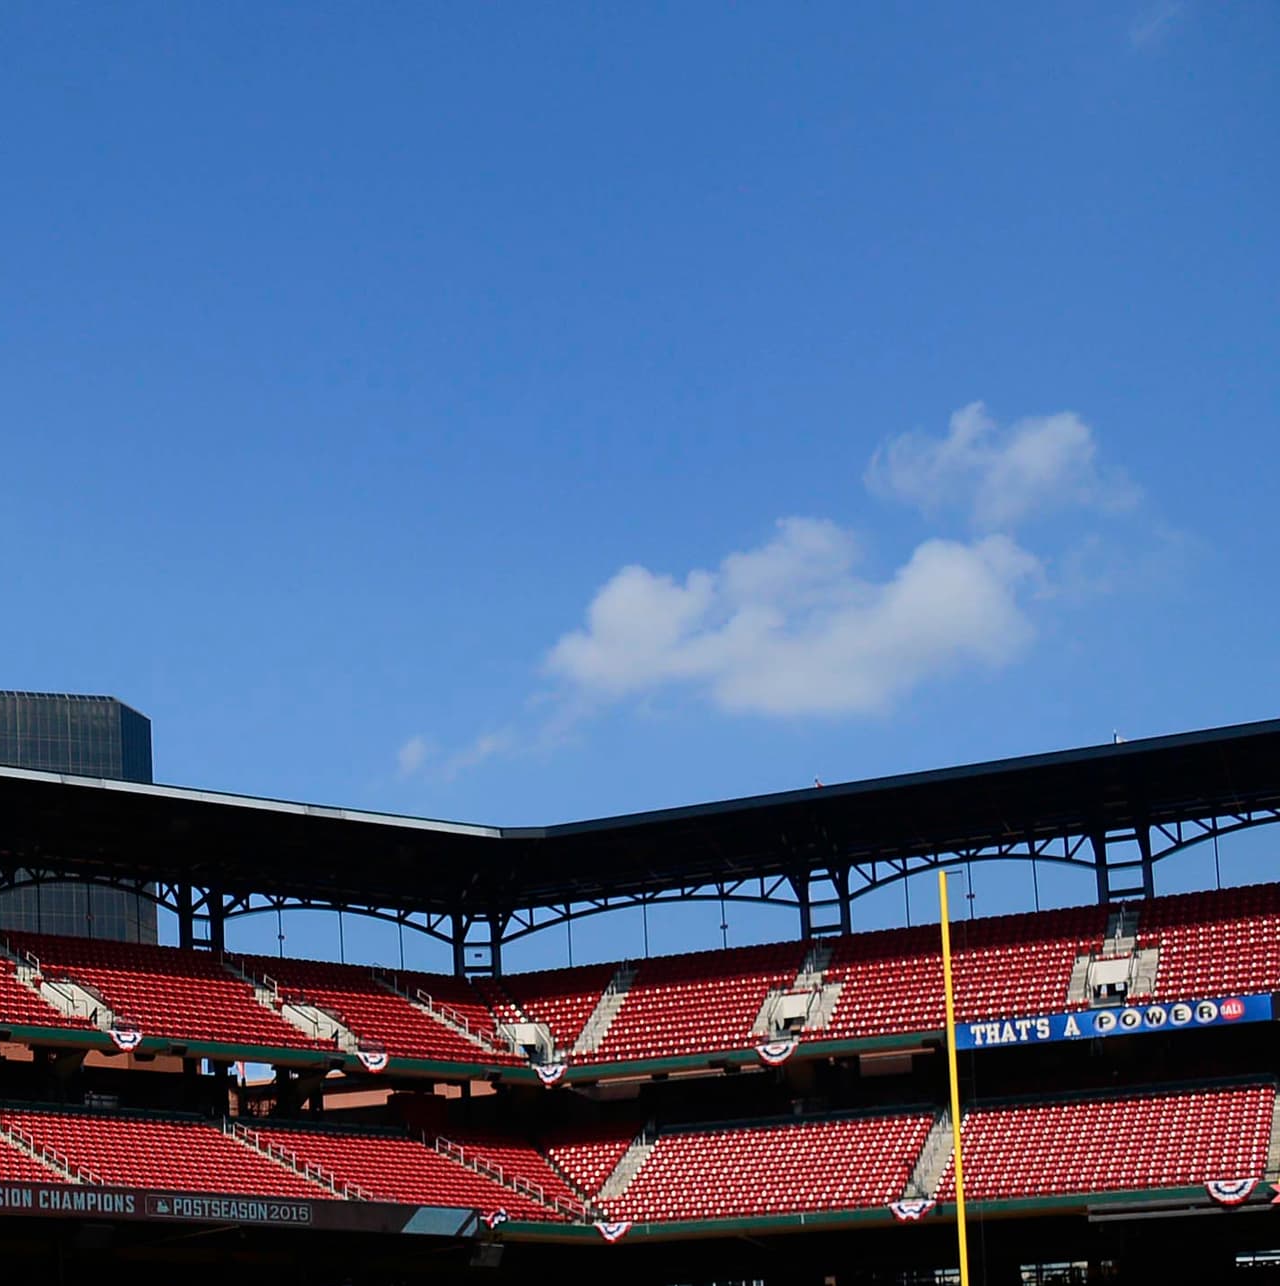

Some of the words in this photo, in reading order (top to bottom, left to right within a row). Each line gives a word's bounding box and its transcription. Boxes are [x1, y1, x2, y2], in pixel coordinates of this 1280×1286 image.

[970, 1018, 1050, 1046] THAT'S
[1064, 1015, 1080, 1037] A
[39, 1190, 135, 1213] CHAMPIONS
